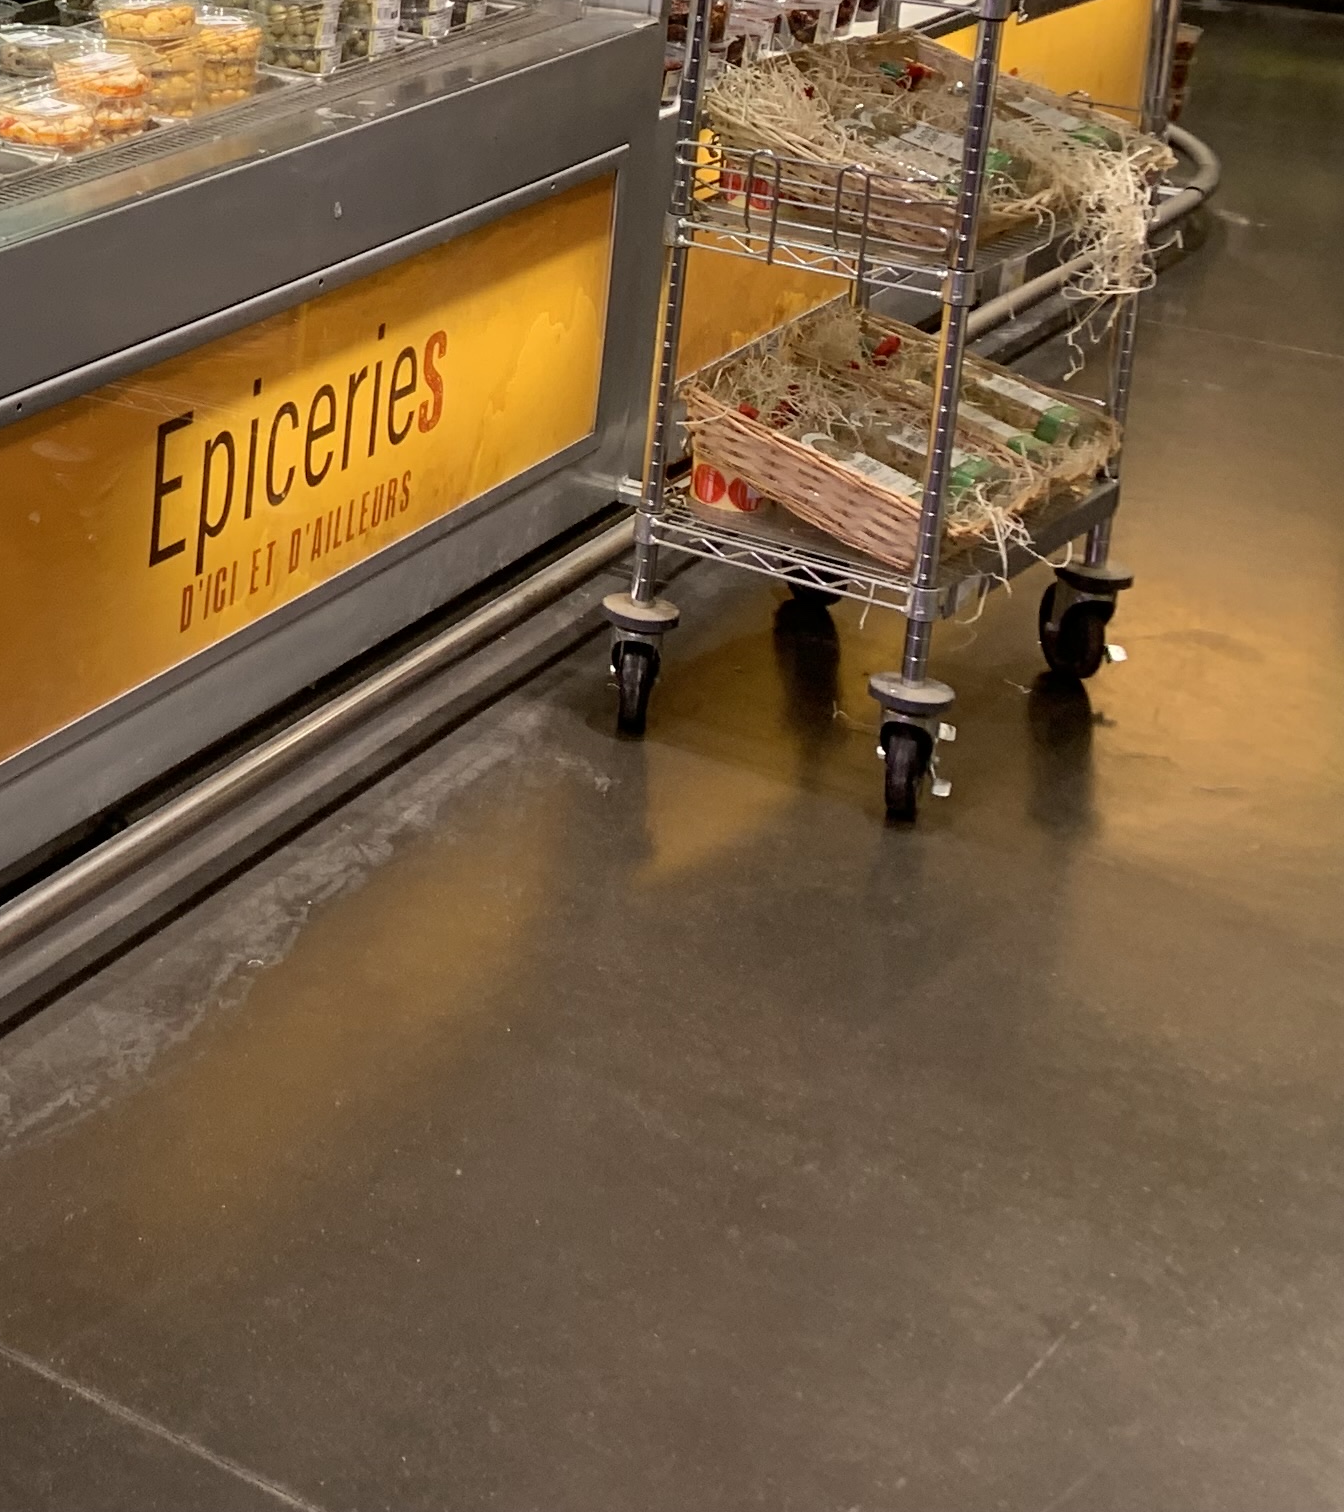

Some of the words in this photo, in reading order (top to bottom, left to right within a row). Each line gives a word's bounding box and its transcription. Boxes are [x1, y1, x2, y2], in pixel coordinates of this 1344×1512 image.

[148, 323, 448, 577] Epiceries
[180, 560, 238, 634] D'ICI
[249, 540, 278, 596] ET
[288, 469, 412, 576] D'AILLEURS
